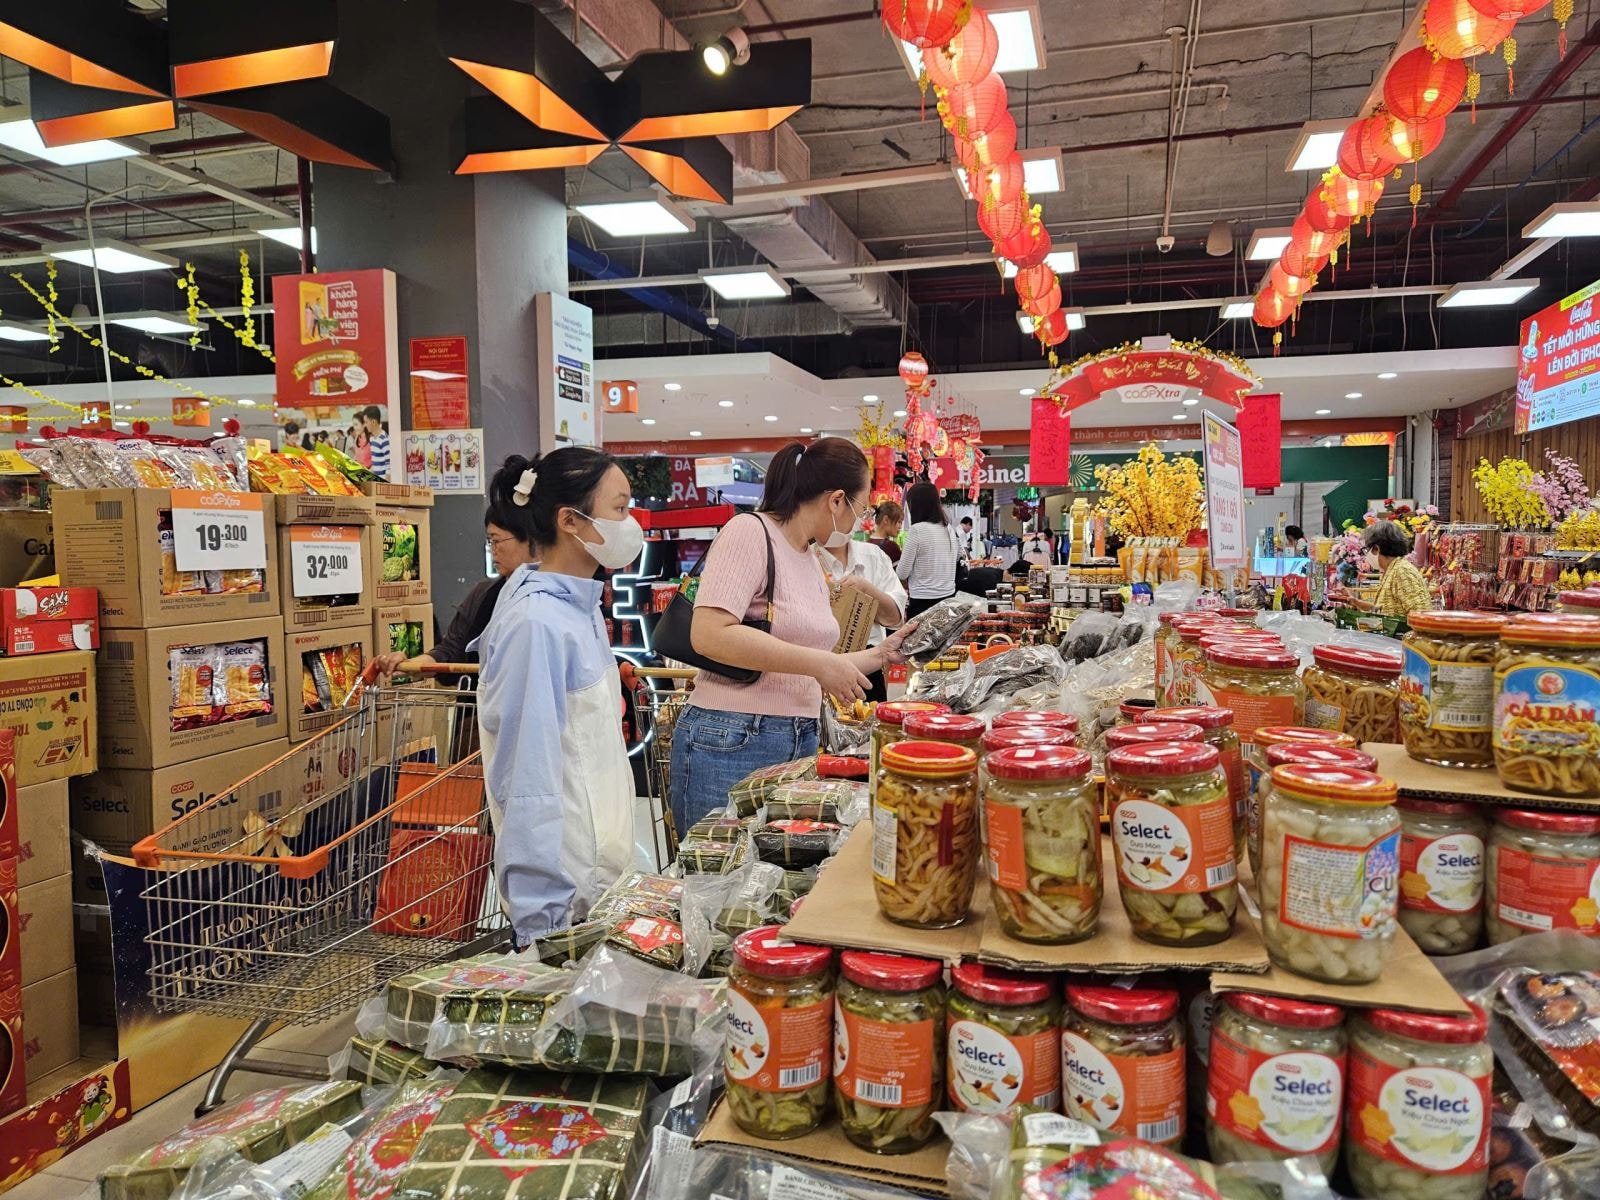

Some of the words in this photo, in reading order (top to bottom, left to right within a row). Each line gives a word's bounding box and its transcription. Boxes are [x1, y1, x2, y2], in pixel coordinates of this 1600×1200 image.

[330, 290, 358, 300] khách
[336, 300, 358, 310] hàng
[333, 310, 358, 320] thành
[340, 321, 358, 329] viên
[608, 387, 622, 406] 9
[82, 408, 98, 424] 14
[224, 646, 253, 656] Select
[83, 796, 129, 813] Select
[1121, 820, 1172, 840] Select
[1438, 853, 1480, 866] Select
[958, 1039, 1006, 1068] Select
[887, 1071, 905, 1079] 450g
[1064, 1052, 1105, 1085] Select
[881, 1077, 897, 1085] 175g
[1274, 1075, 1332, 1095] Select
[1405, 1089, 1470, 1113] Select
